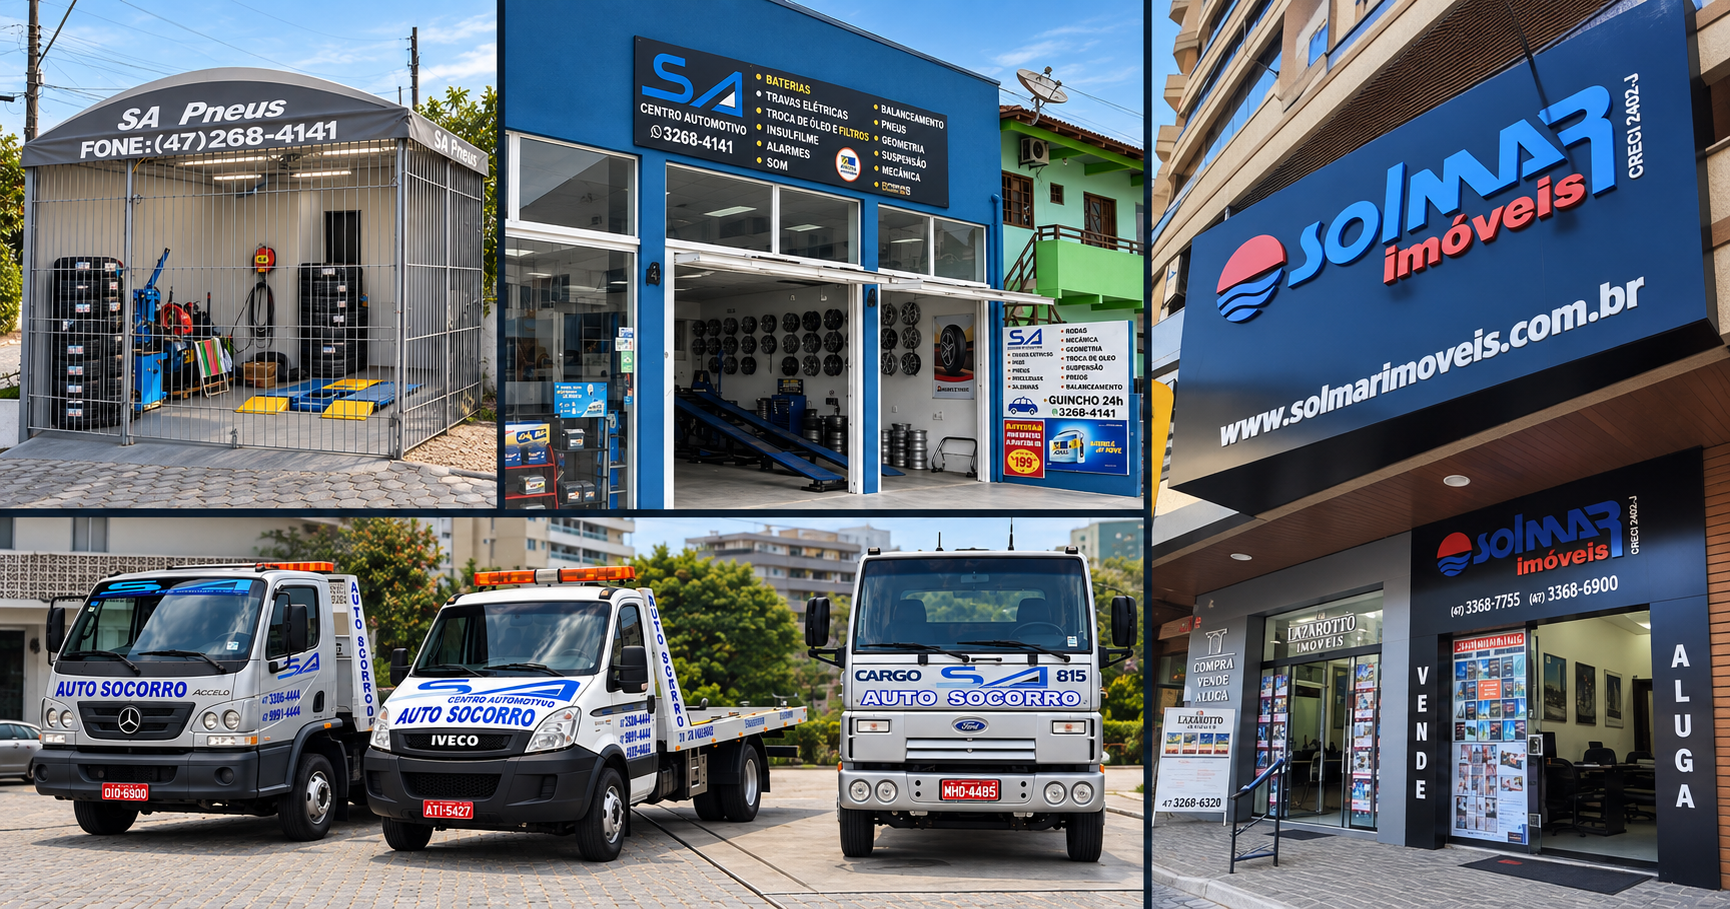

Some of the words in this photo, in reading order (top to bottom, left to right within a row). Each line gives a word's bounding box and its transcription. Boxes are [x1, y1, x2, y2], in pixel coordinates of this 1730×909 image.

[642, 53, 743, 118] SA
[766, 74, 811, 95] BATERIAS
[766, 91, 801, 109] TRAVAS
[803, 99, 849, 120] ELÉTRICAS
[1624, 73, 1640, 126] 2402-J
[118, 105, 160, 131] SA
[179, 99, 287, 126] Pneus
[640, 103, 682, 121] CENTRO
[684, 113, 747, 136] AUTOMOTIVO
[766, 108, 796, 125] TROCA
[797, 115, 808, 127] DE
[809, 116, 831, 133] ÓLEO
[832, 124, 838, 135] E
[839, 126, 870, 142] FILTROS
[881, 104, 944, 130] BALANCEAMENTO
[766, 124, 819, 146] INSULFILME
[881, 120, 907, 135] PNEUS
[434, 130, 448, 153] SA
[663, 126, 734, 154] 3268-4141
[766, 141, 811, 160] ALARMES
[882, 135, 925, 155] GEOMETRIA
[1627, 125, 1644, 179] CRECI
[766, 157, 788, 171] SOM
[1382, 173, 1587, 285] imóveis
[1007, 328, 1042, 345] SA
[1219, 276, 1645, 447] www.solmarimoveis.com.br
[1049, 395, 1099, 406] GUINCHO
[1103, 396, 1123, 406] 24h
[1059, 408, 1116, 418] 3268-4141
[1517, 542, 1609, 576] imóveis
[1466, 592, 1521, 615] 3368-7755
[1548, 575, 1619, 602] 3368-6900
[1296, 635, 1343, 653] IMOVEIS
[855, 669, 922, 682] CARGO
[1056, 669, 1087, 682] 815
[1194, 658, 1234, 673] COMPRA
[55, 681, 97, 698] AUTO
[100, 681, 187, 698] SOCORRO
[192, 688, 230, 696] ACCELO
[447, 696, 487, 704] CENTRO
[860, 690, 938, 706] AUTO
[947, 690, 1081, 707] SOCORRO
[395, 706, 442, 725] AUTO
[446, 706, 536, 727] SOCORRO
[1671, 644, 1696, 809] ALUGA
[431, 735, 479, 746] IVECO
[1415, 666, 1429, 800] VENDE
[1173, 797, 1221, 808] 3268-6320
